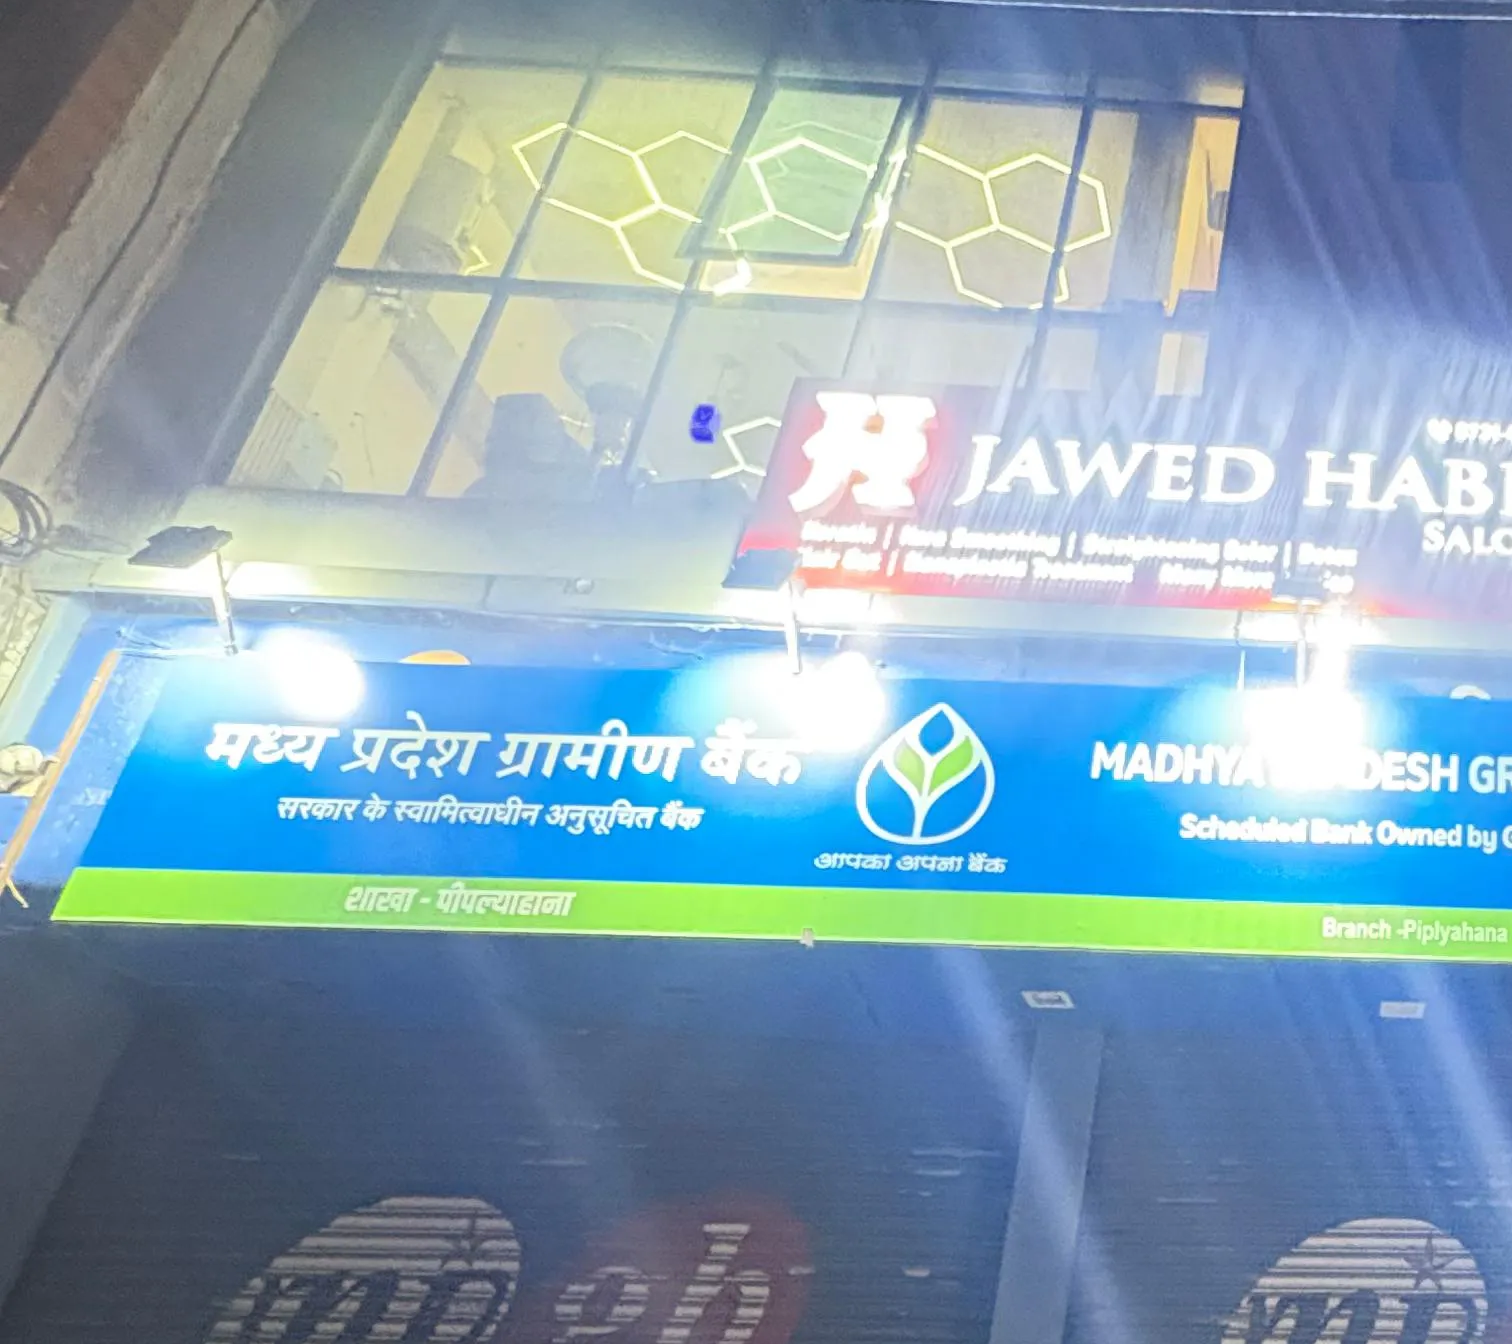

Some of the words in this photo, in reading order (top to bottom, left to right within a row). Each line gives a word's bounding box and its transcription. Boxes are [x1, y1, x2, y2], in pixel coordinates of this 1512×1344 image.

[954, 435, 1277, 508] JAWED
[205, 722, 341, 772] मध्य
[340, 710, 493, 780] प्रदेश
[496, 718, 696, 783] ग्रामीण
[700, 717, 808, 787] बैंक
[1090, 740, 1266, 789] MADHYA
[277, 796, 362, 822] सरकार
[362, 792, 393, 823] के
[393, 793, 545, 828] स्वामित्वाधीन
[545, 798, 660, 836] अनुसूचित
[660, 799, 705, 832] बैंक
[1179, 812, 1309, 844] Scheduled
[1310, 817, 1374, 845] Bank
[1376, 819, 1463, 847] Owned
[1465, 823, 1498, 855] by
[814, 852, 893, 871] आपका
[896, 853, 964, 873] अपना
[967, 851, 1009, 874] बैंक
[344, 885, 420, 914] शाखा
[1322, 915, 1393, 939] Branch
